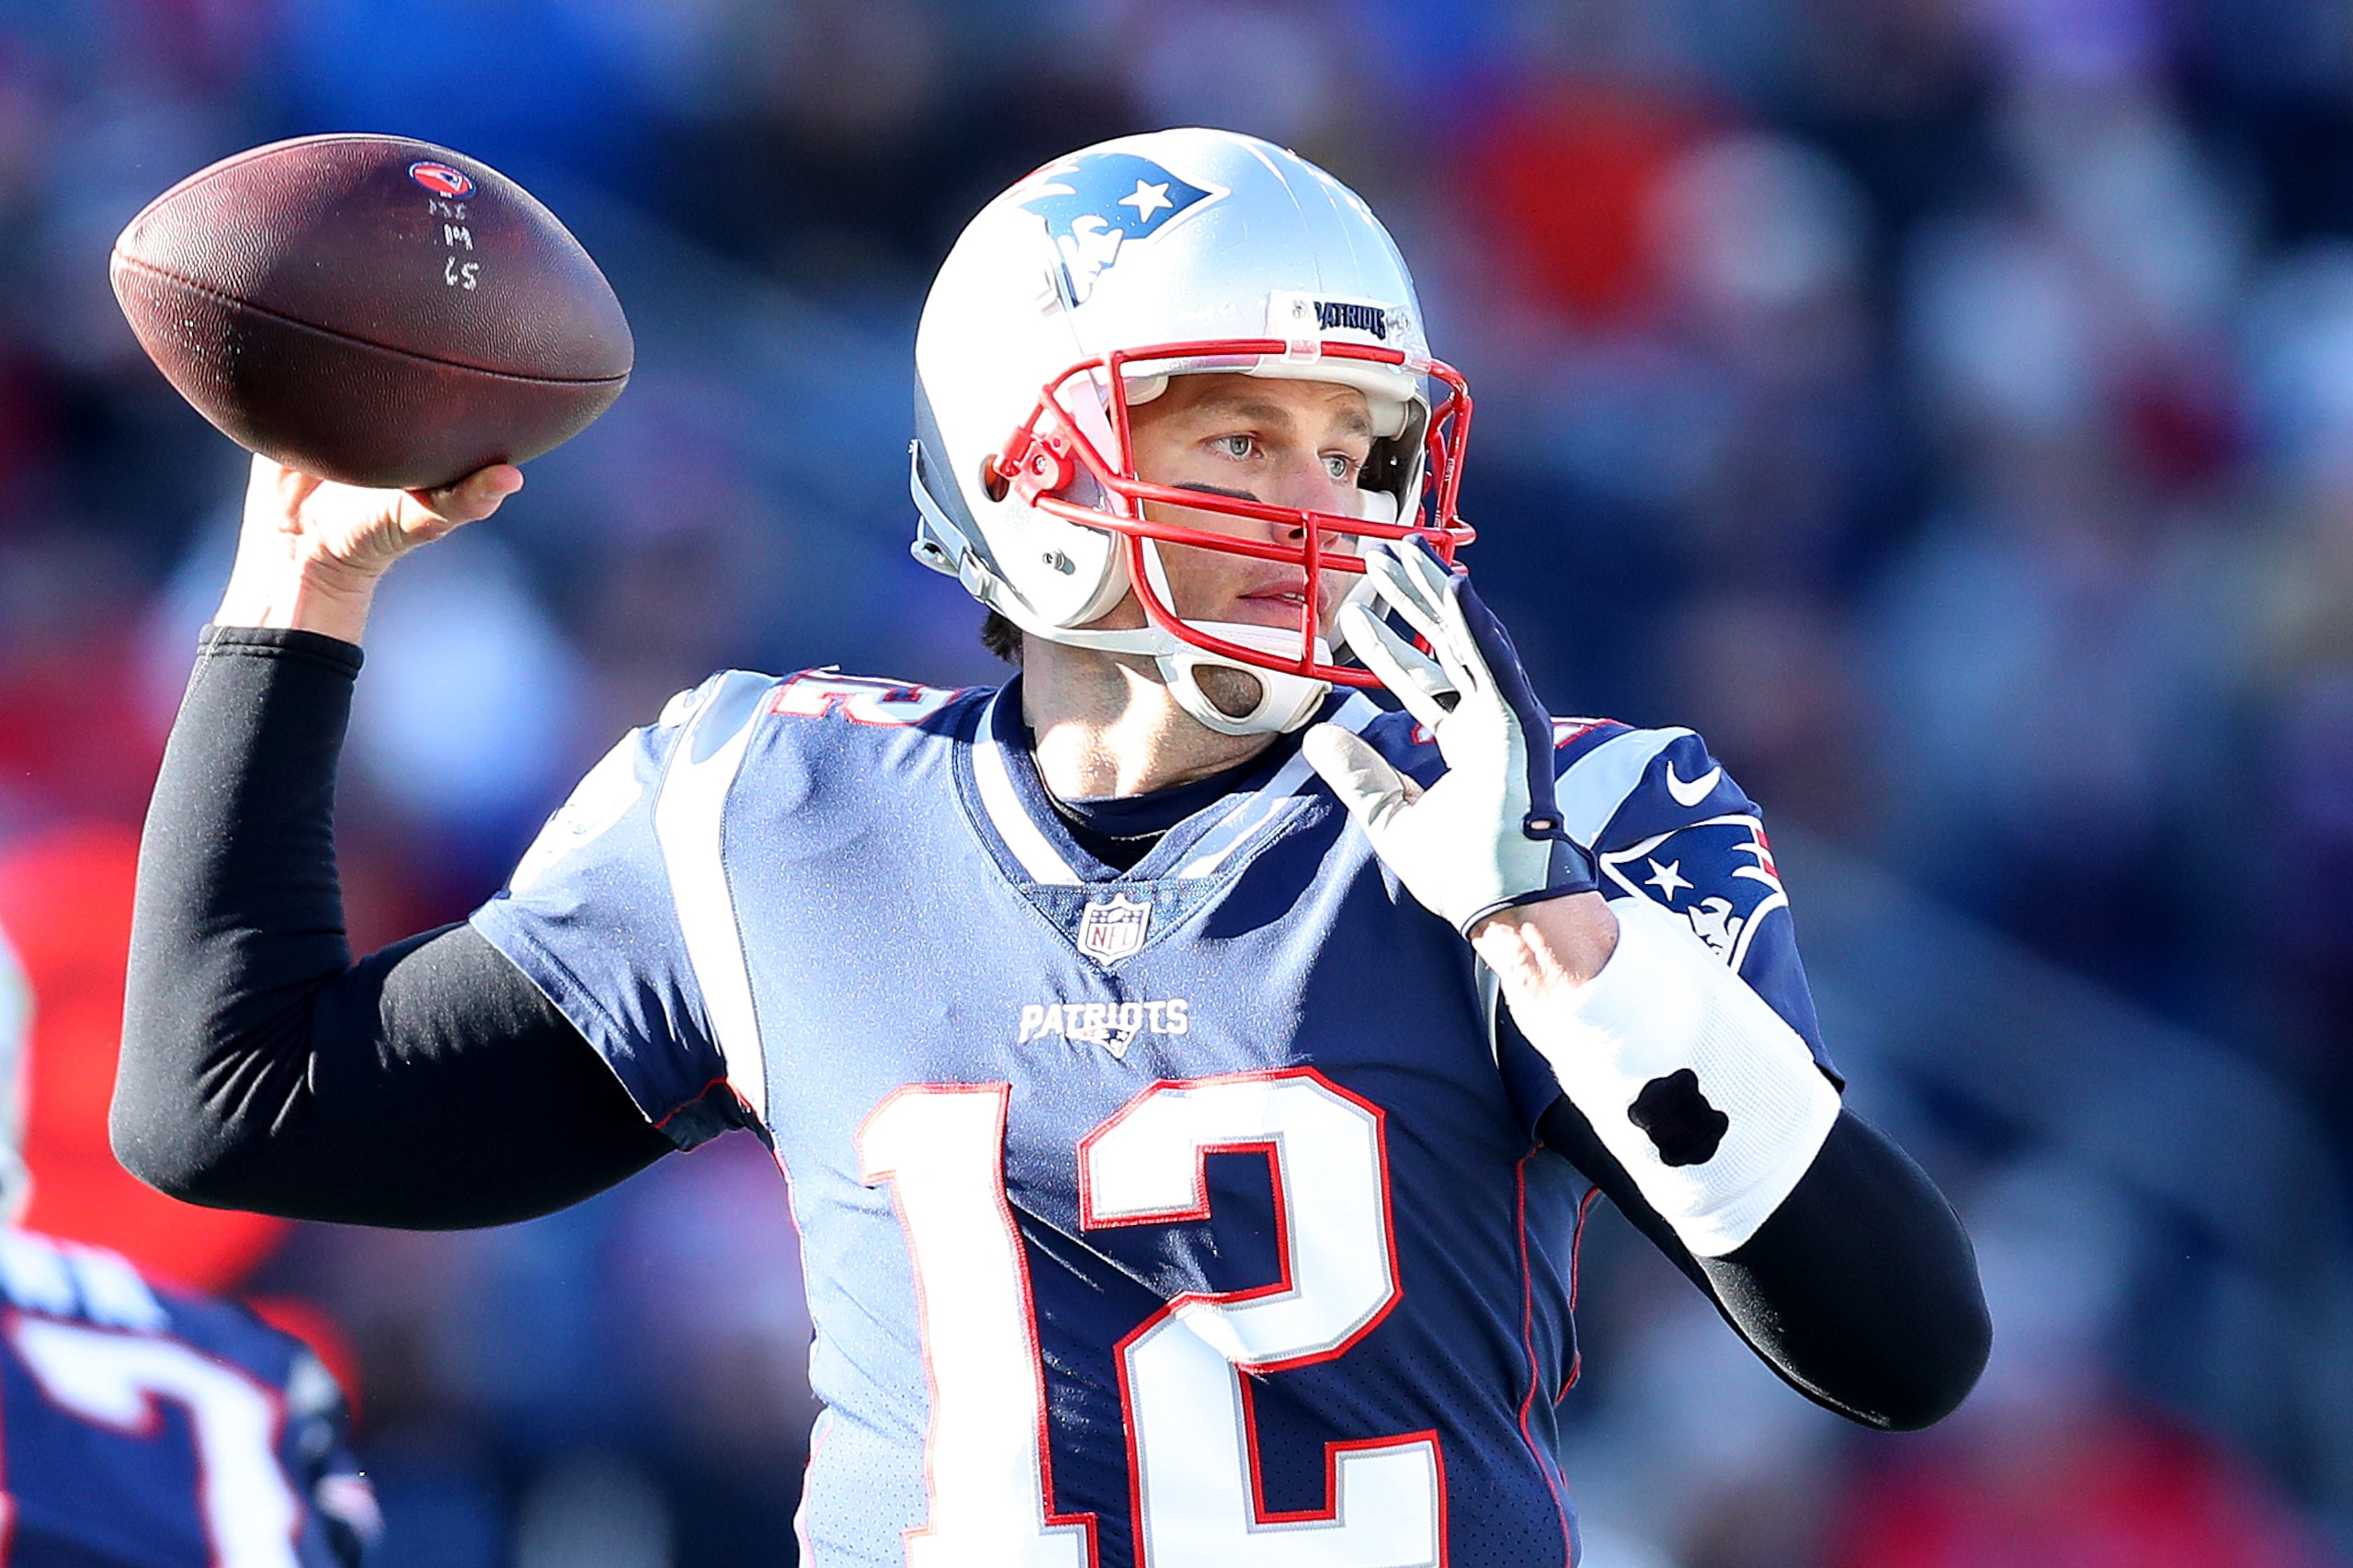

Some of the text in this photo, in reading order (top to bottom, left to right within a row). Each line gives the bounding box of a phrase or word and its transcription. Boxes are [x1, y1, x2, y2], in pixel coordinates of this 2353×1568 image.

[1091, 926, 1132, 950] NFL
[1018, 999, 1188, 1044] PATRIOTS
[855, 1066, 1447, 1568] 12
